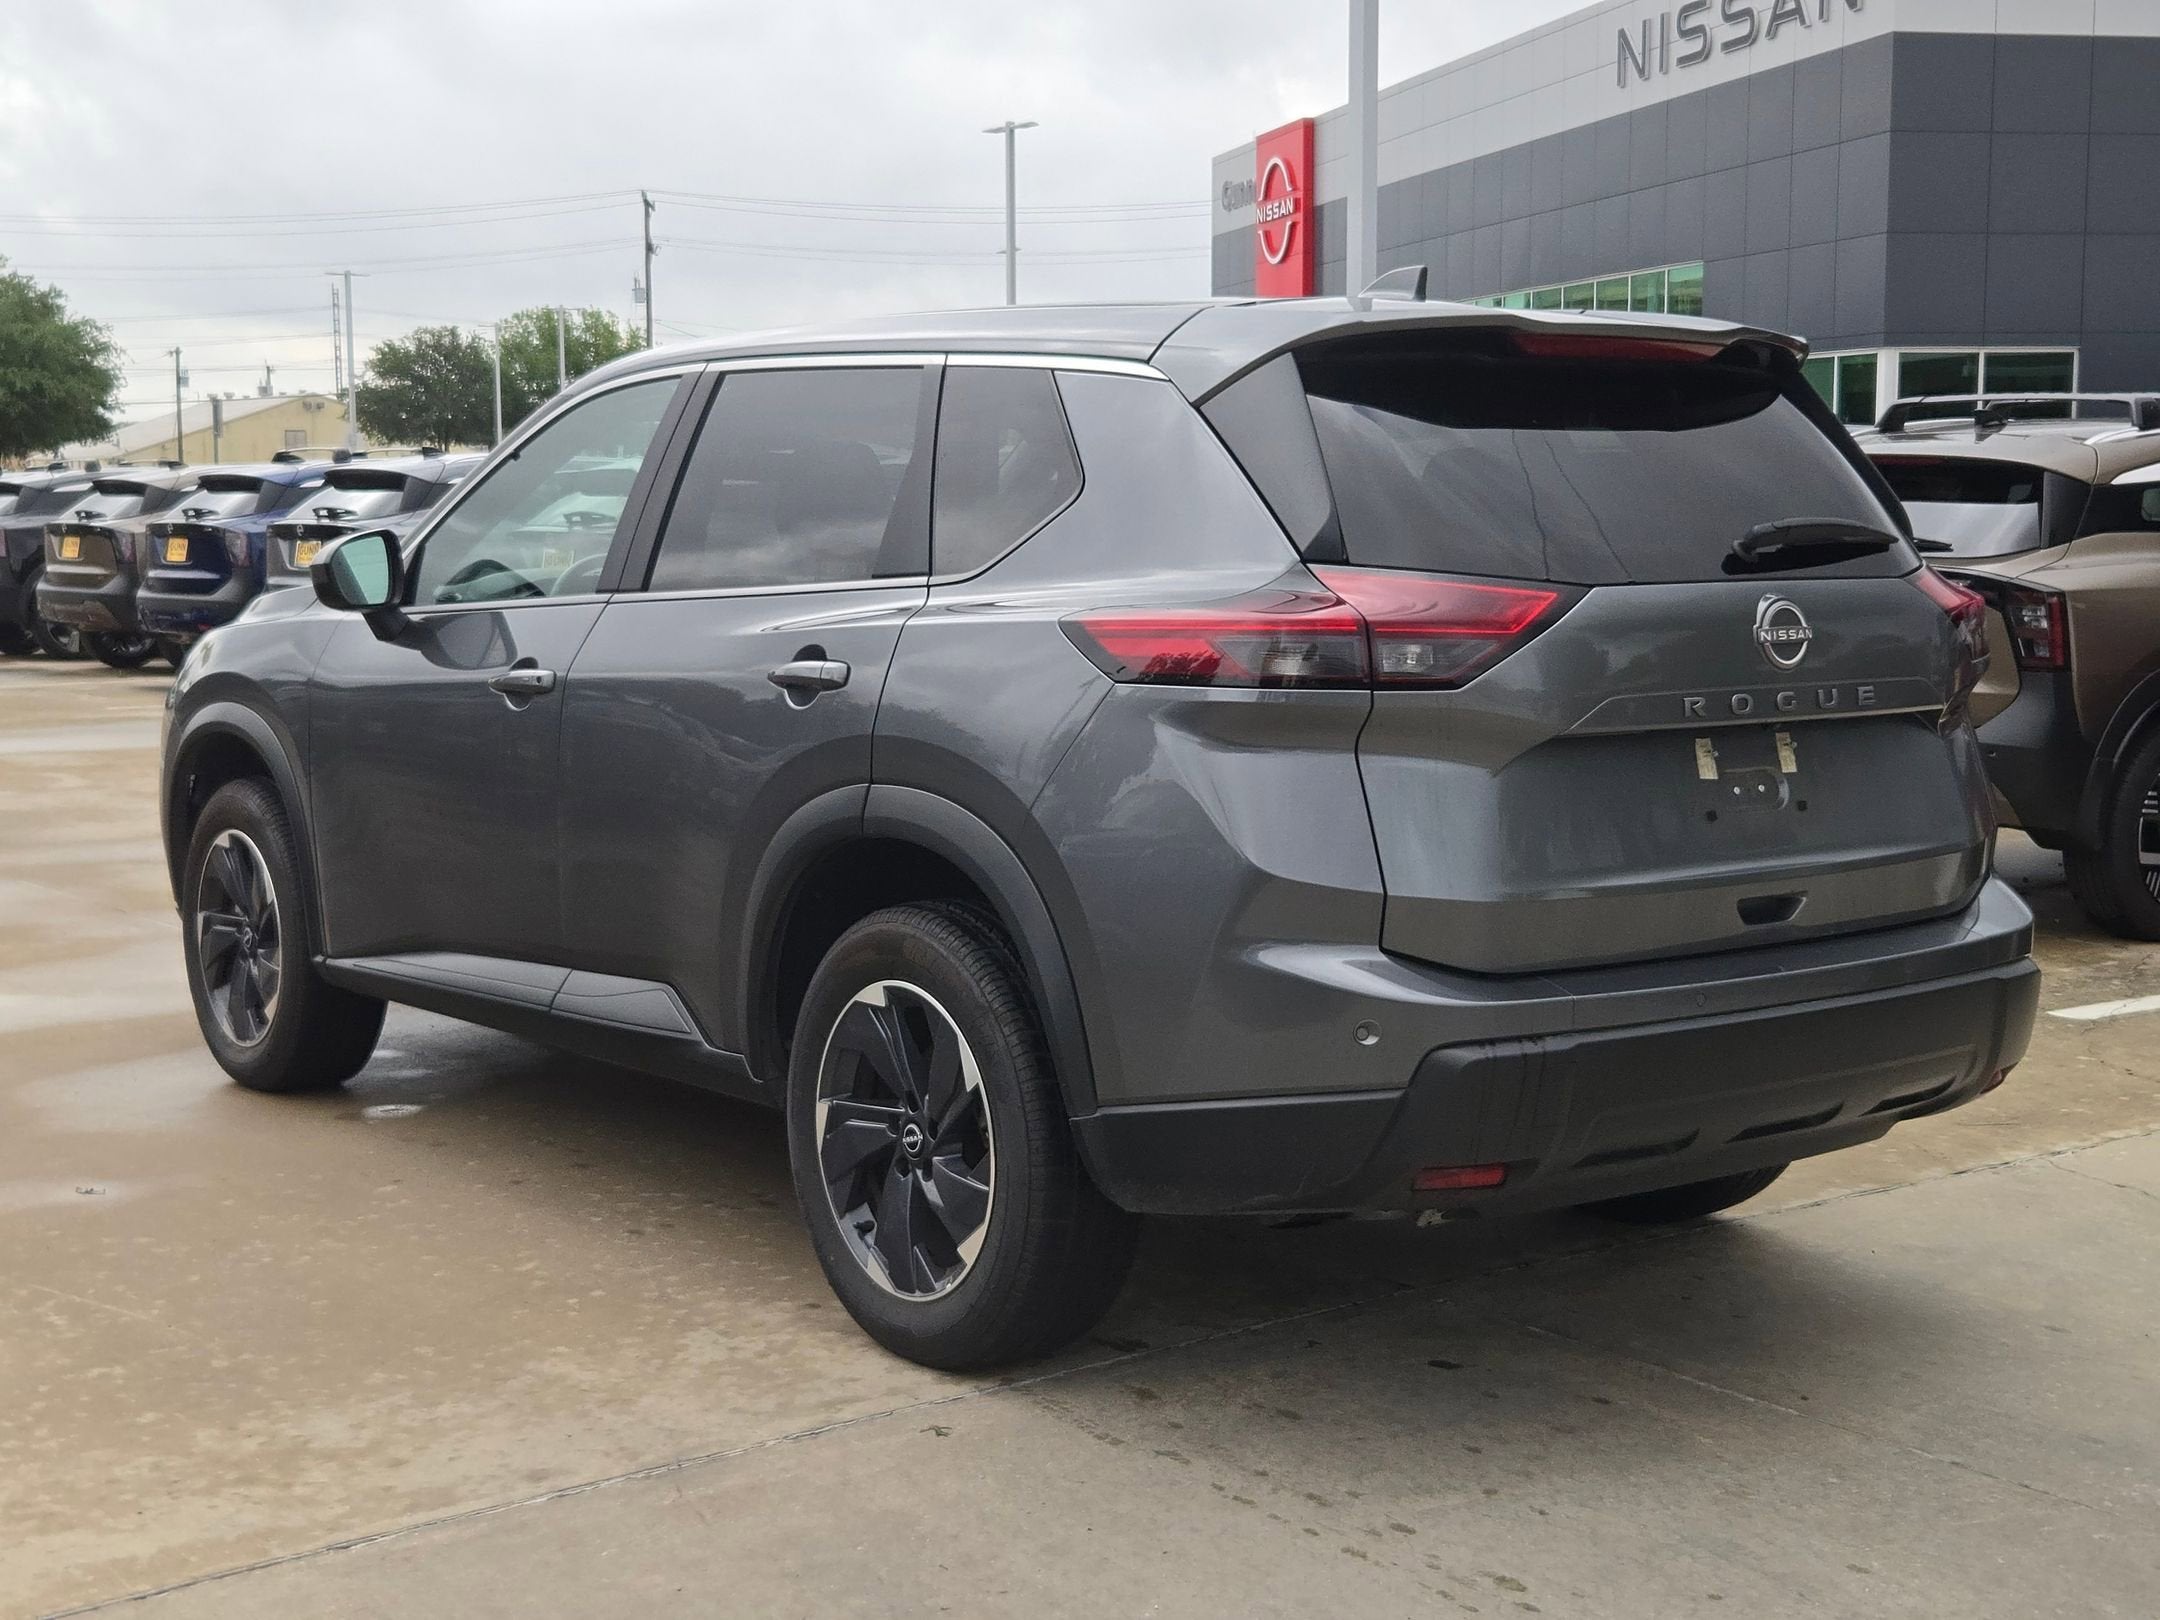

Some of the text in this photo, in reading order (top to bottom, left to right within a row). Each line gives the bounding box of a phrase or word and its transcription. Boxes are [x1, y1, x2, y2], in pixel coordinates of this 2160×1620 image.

[1256, 196, 1294, 225] NISSAN
[1760, 628, 1813, 642] NISSAN
[1683, 685, 1876, 718] ROGUE
